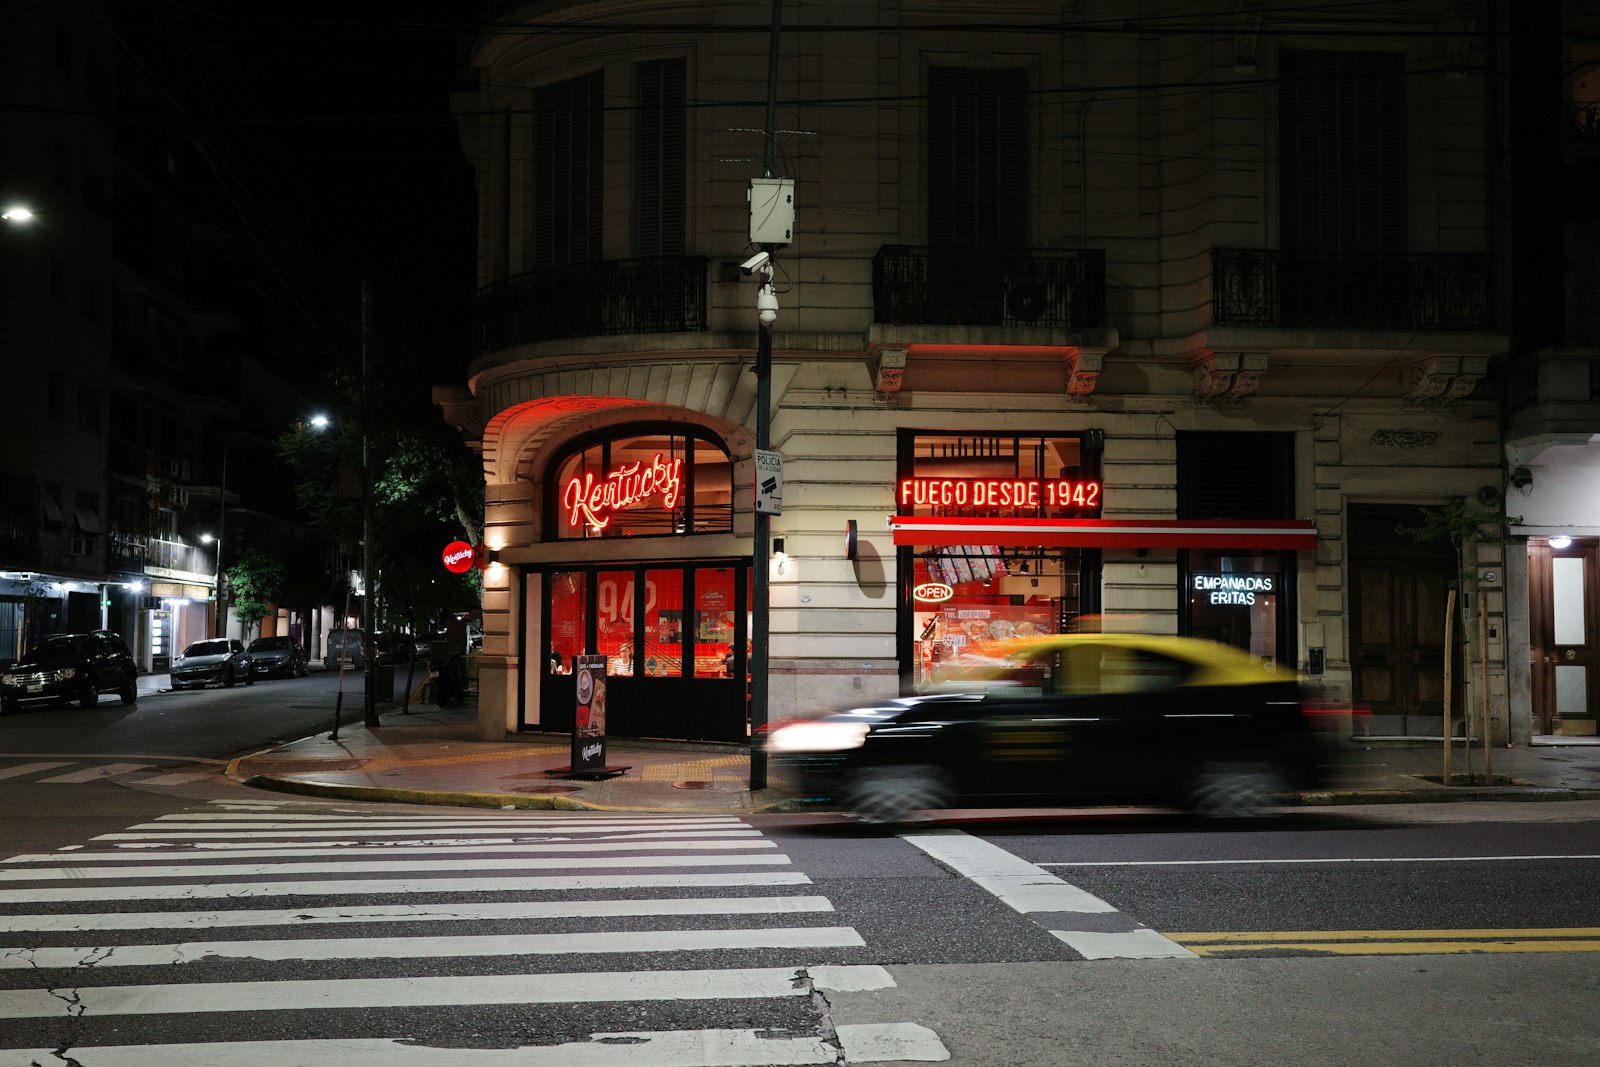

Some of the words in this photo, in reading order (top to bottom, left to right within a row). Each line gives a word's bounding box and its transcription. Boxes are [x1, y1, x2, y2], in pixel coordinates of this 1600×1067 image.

[757, 455, 781, 466] POLICIA
[563, 453, 684, 528] Kentucky
[902, 480, 967, 505] FUEGO
[973, 481, 1039, 506] DESDE
[1047, 482, 1099, 506] 1942
[444, 548, 473, 565] Kentucky
[1194, 575, 1272, 591] EMPANADAS
[917, 586, 949, 598] OPEN
